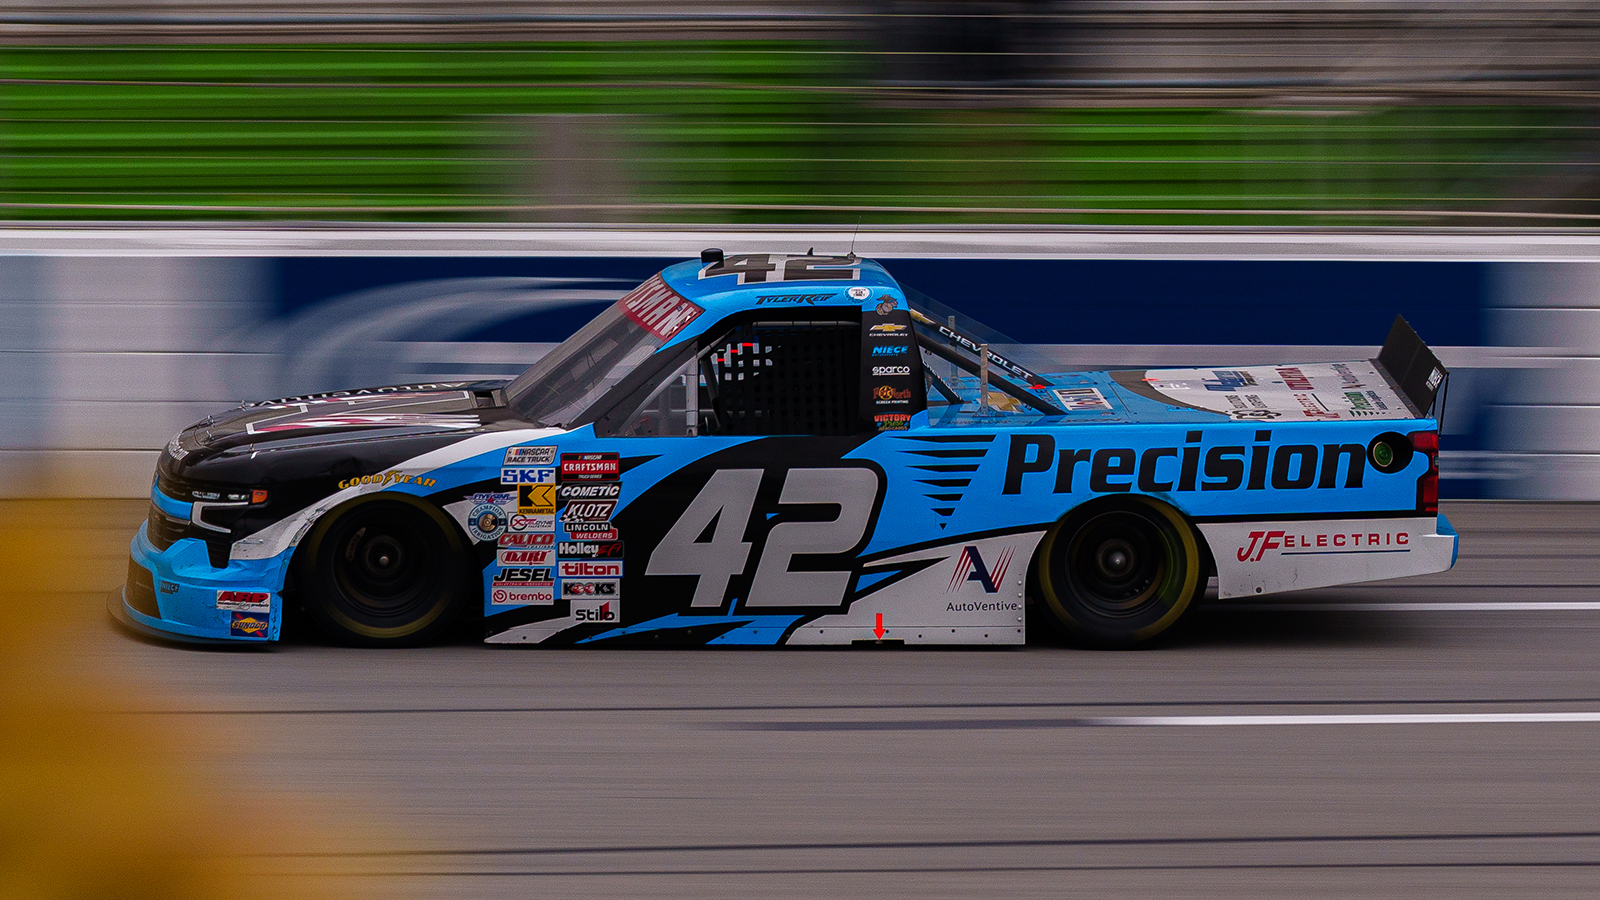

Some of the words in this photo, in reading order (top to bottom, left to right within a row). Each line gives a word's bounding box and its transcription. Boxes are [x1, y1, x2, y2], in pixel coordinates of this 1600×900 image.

[698, 253, 861, 285] 42
[872, 346, 908, 354] NIECE
[939, 326, 1033, 379] CHEVROLET
[872, 366, 910, 376] sparco
[874, 414, 911, 422] VICTORY
[564, 462, 616, 472] CRAFTSMAN
[1002, 430, 1367, 495] Precision
[338, 470, 437, 489] GOODYEAR
[502, 469, 554, 483] SKF
[561, 484, 620, 497] COMETIC
[472, 505, 503, 517] CHAMPION
[567, 503, 612, 518] KLOTZ
[472, 527, 503, 540] IRRIGATION
[566, 524, 609, 532] LINCOLN
[499, 534, 555, 546] CALICO
[644, 468, 879, 607] 42
[1284, 532, 1410, 549] ELECTRIC
[505, 550, 551, 562] DART
[559, 543, 599, 557] Holley
[494, 569, 554, 581] JESEL
[562, 563, 620, 575] tilton
[218, 591, 269, 602] ARP
[509, 592, 552, 601] brembo
[575, 601, 615, 620] Stilo
[946, 600, 1017, 612] AutoVentive
[233, 621, 268, 630] SUNOCO
